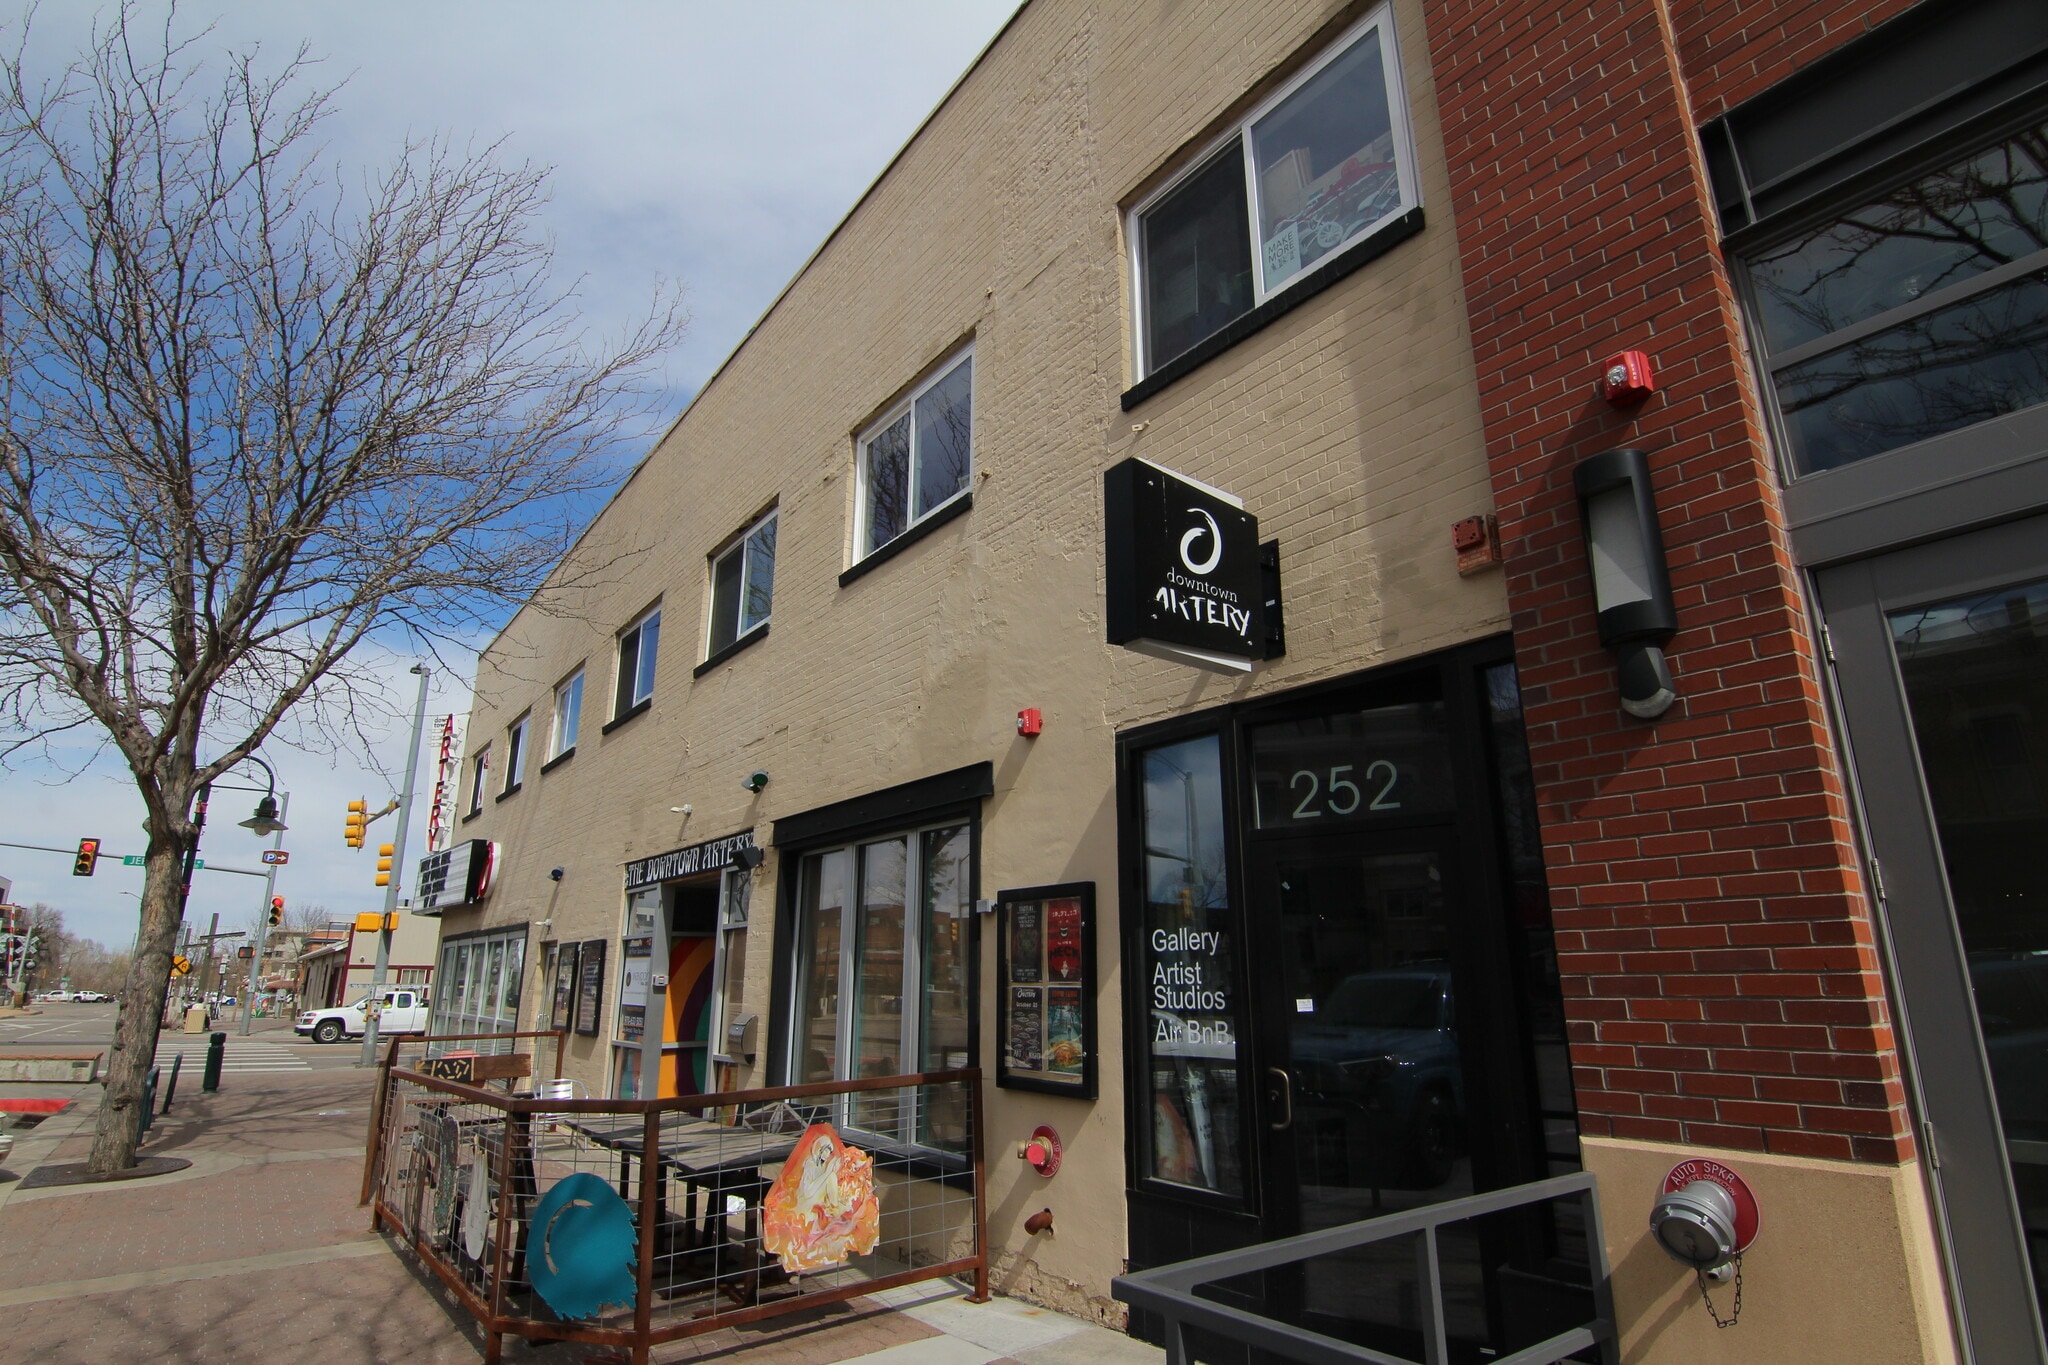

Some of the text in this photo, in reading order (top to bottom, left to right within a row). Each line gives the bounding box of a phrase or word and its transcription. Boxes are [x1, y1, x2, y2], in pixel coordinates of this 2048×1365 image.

[1268, 232, 1293, 254] MAKE
[1269, 240, 1295, 264] MORE
[1166, 566, 1238, 603] downtown
[1155, 586, 1250, 637] ARTERY
[428, 713, 453, 852] ARTERY
[1290, 760, 1401, 819] 252
[628, 861, 645, 887] THE
[646, 846, 700, 882] DOWNTOWN
[1152, 927, 1219, 956] Gallery
[1153, 961, 1202, 985] Artist
[1154, 985, 1226, 1010] Studios
[1155, 1019, 1229, 1044] Air BnB
[1671, 1161, 1735, 1186] AUTO SPKR
[1703, 1174, 1737, 1197] CONNECTION
